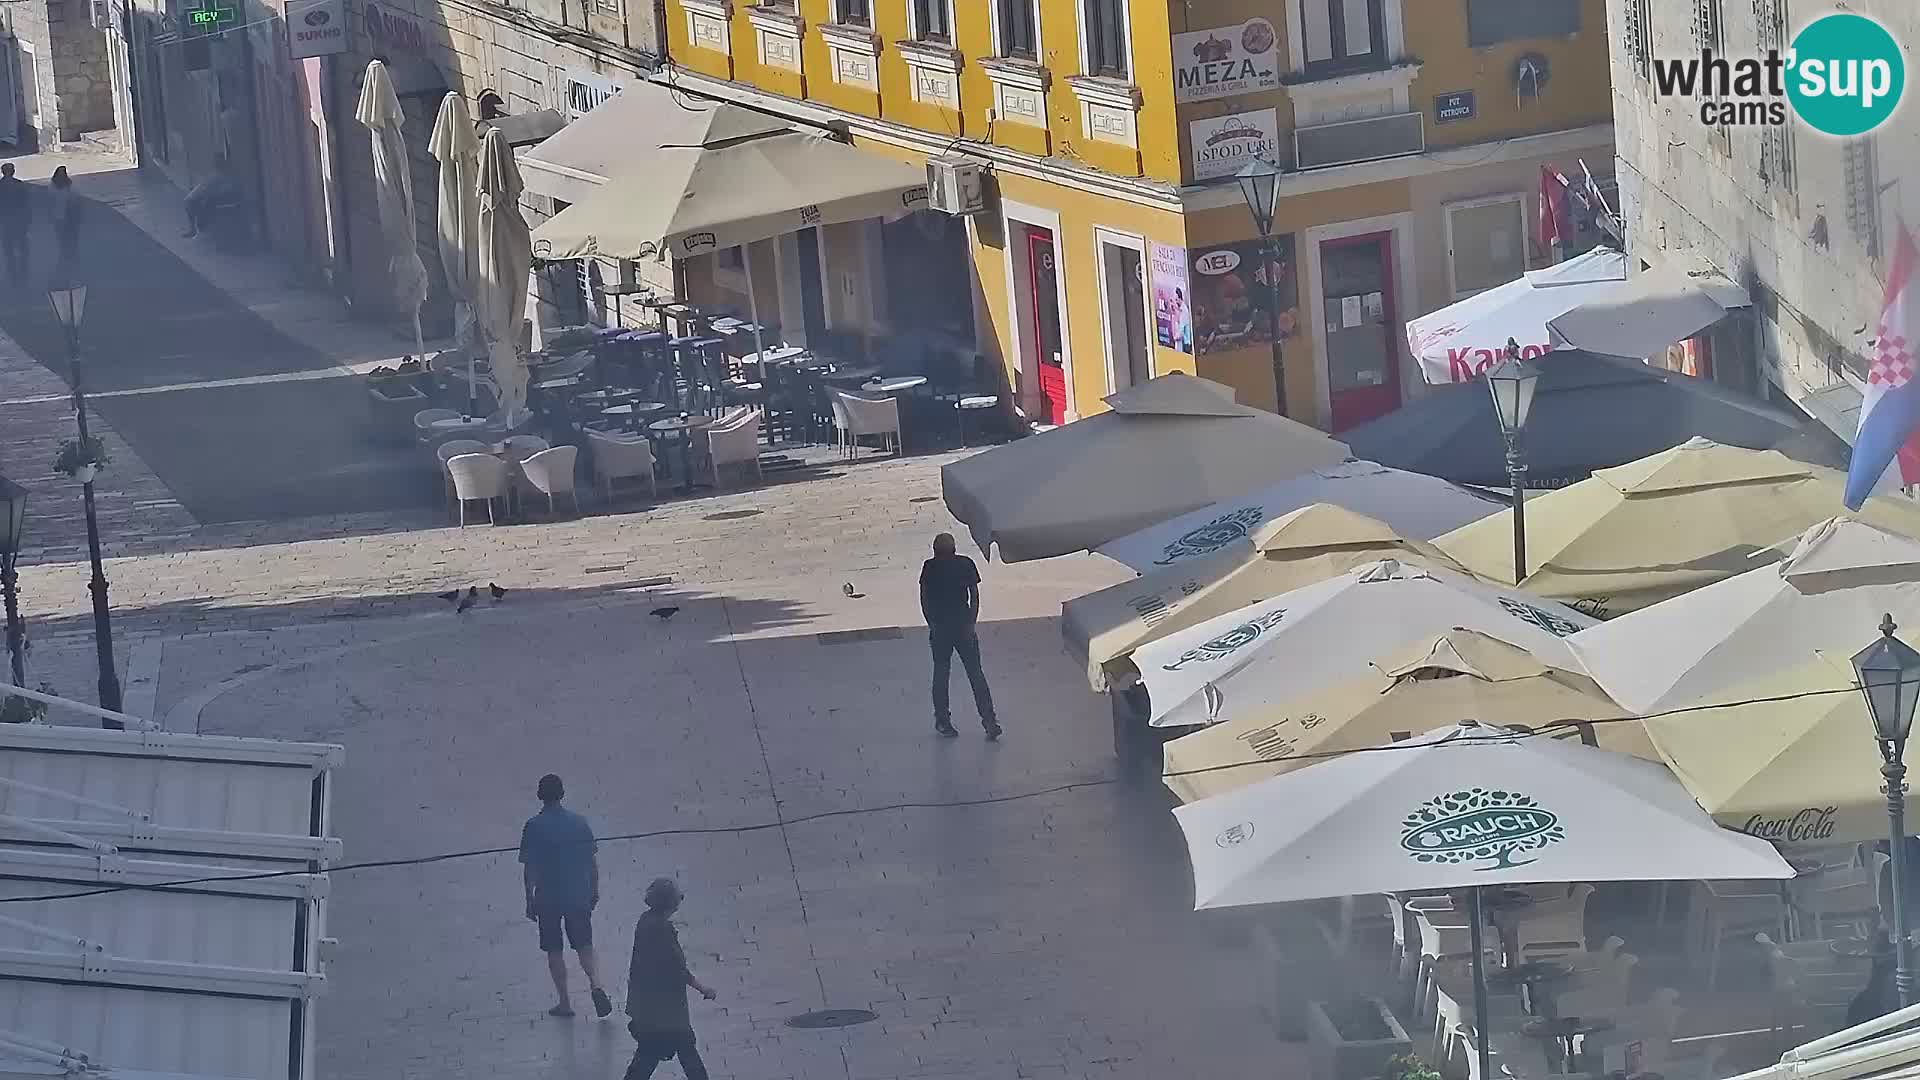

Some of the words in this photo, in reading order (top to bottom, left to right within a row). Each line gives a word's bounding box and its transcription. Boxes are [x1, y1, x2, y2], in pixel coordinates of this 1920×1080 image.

[1178, 58, 1257, 89] MEZA
[1197, 143, 1243, 162] ISPOD
[1441, 813, 1540, 842] RAUCH
